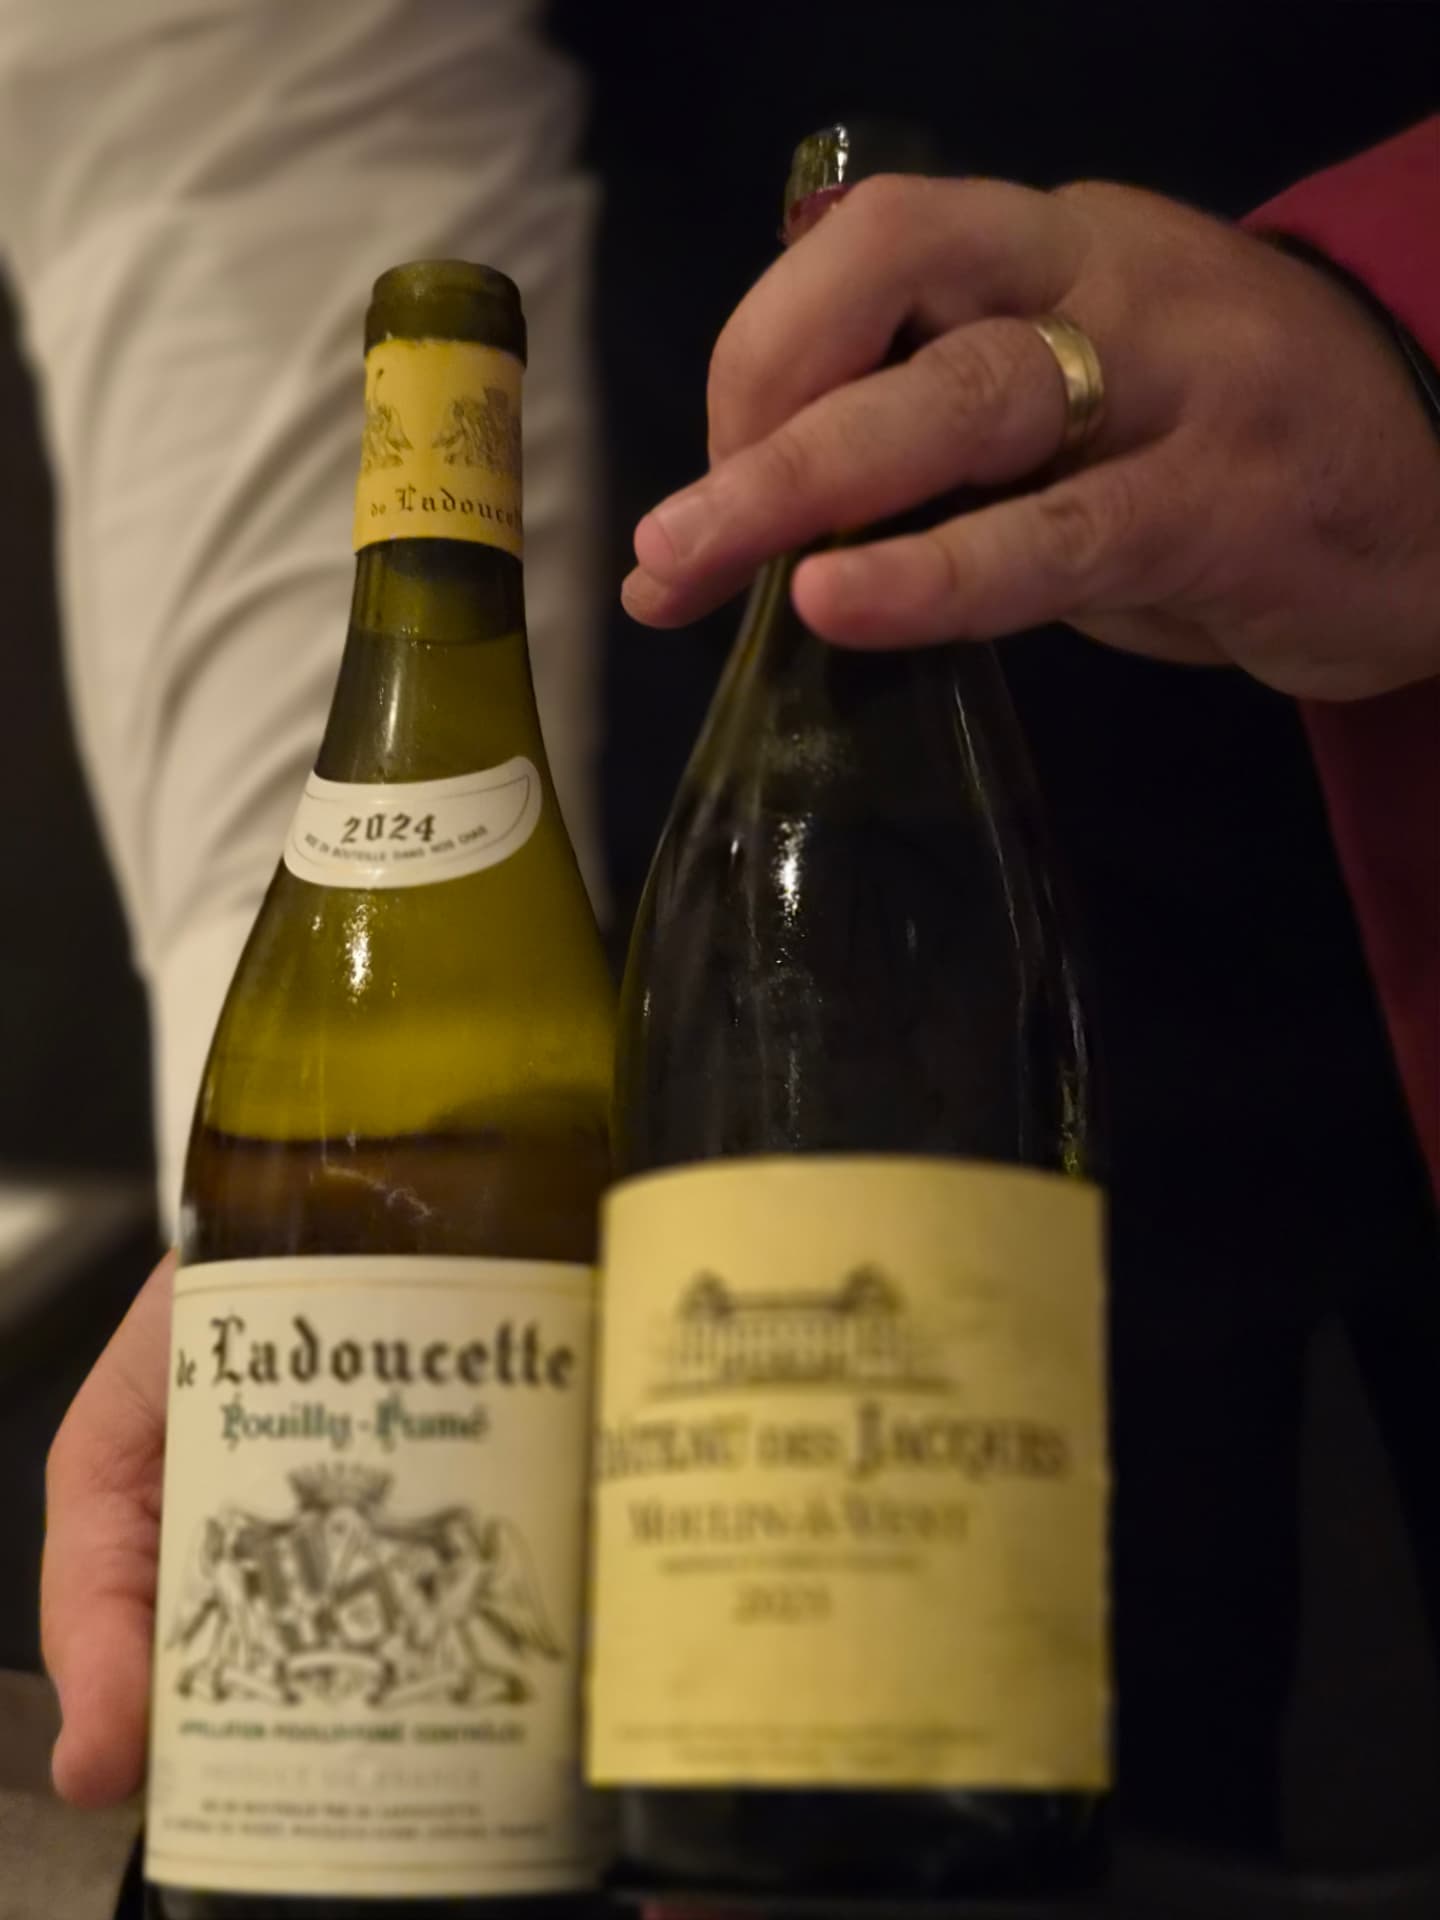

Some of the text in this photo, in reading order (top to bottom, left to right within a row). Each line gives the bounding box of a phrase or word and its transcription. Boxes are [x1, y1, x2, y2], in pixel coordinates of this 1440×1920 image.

[370, 502, 387, 518] de
[340, 813, 436, 845] 2024
[176, 1310, 575, 1390] de Ladoucette
